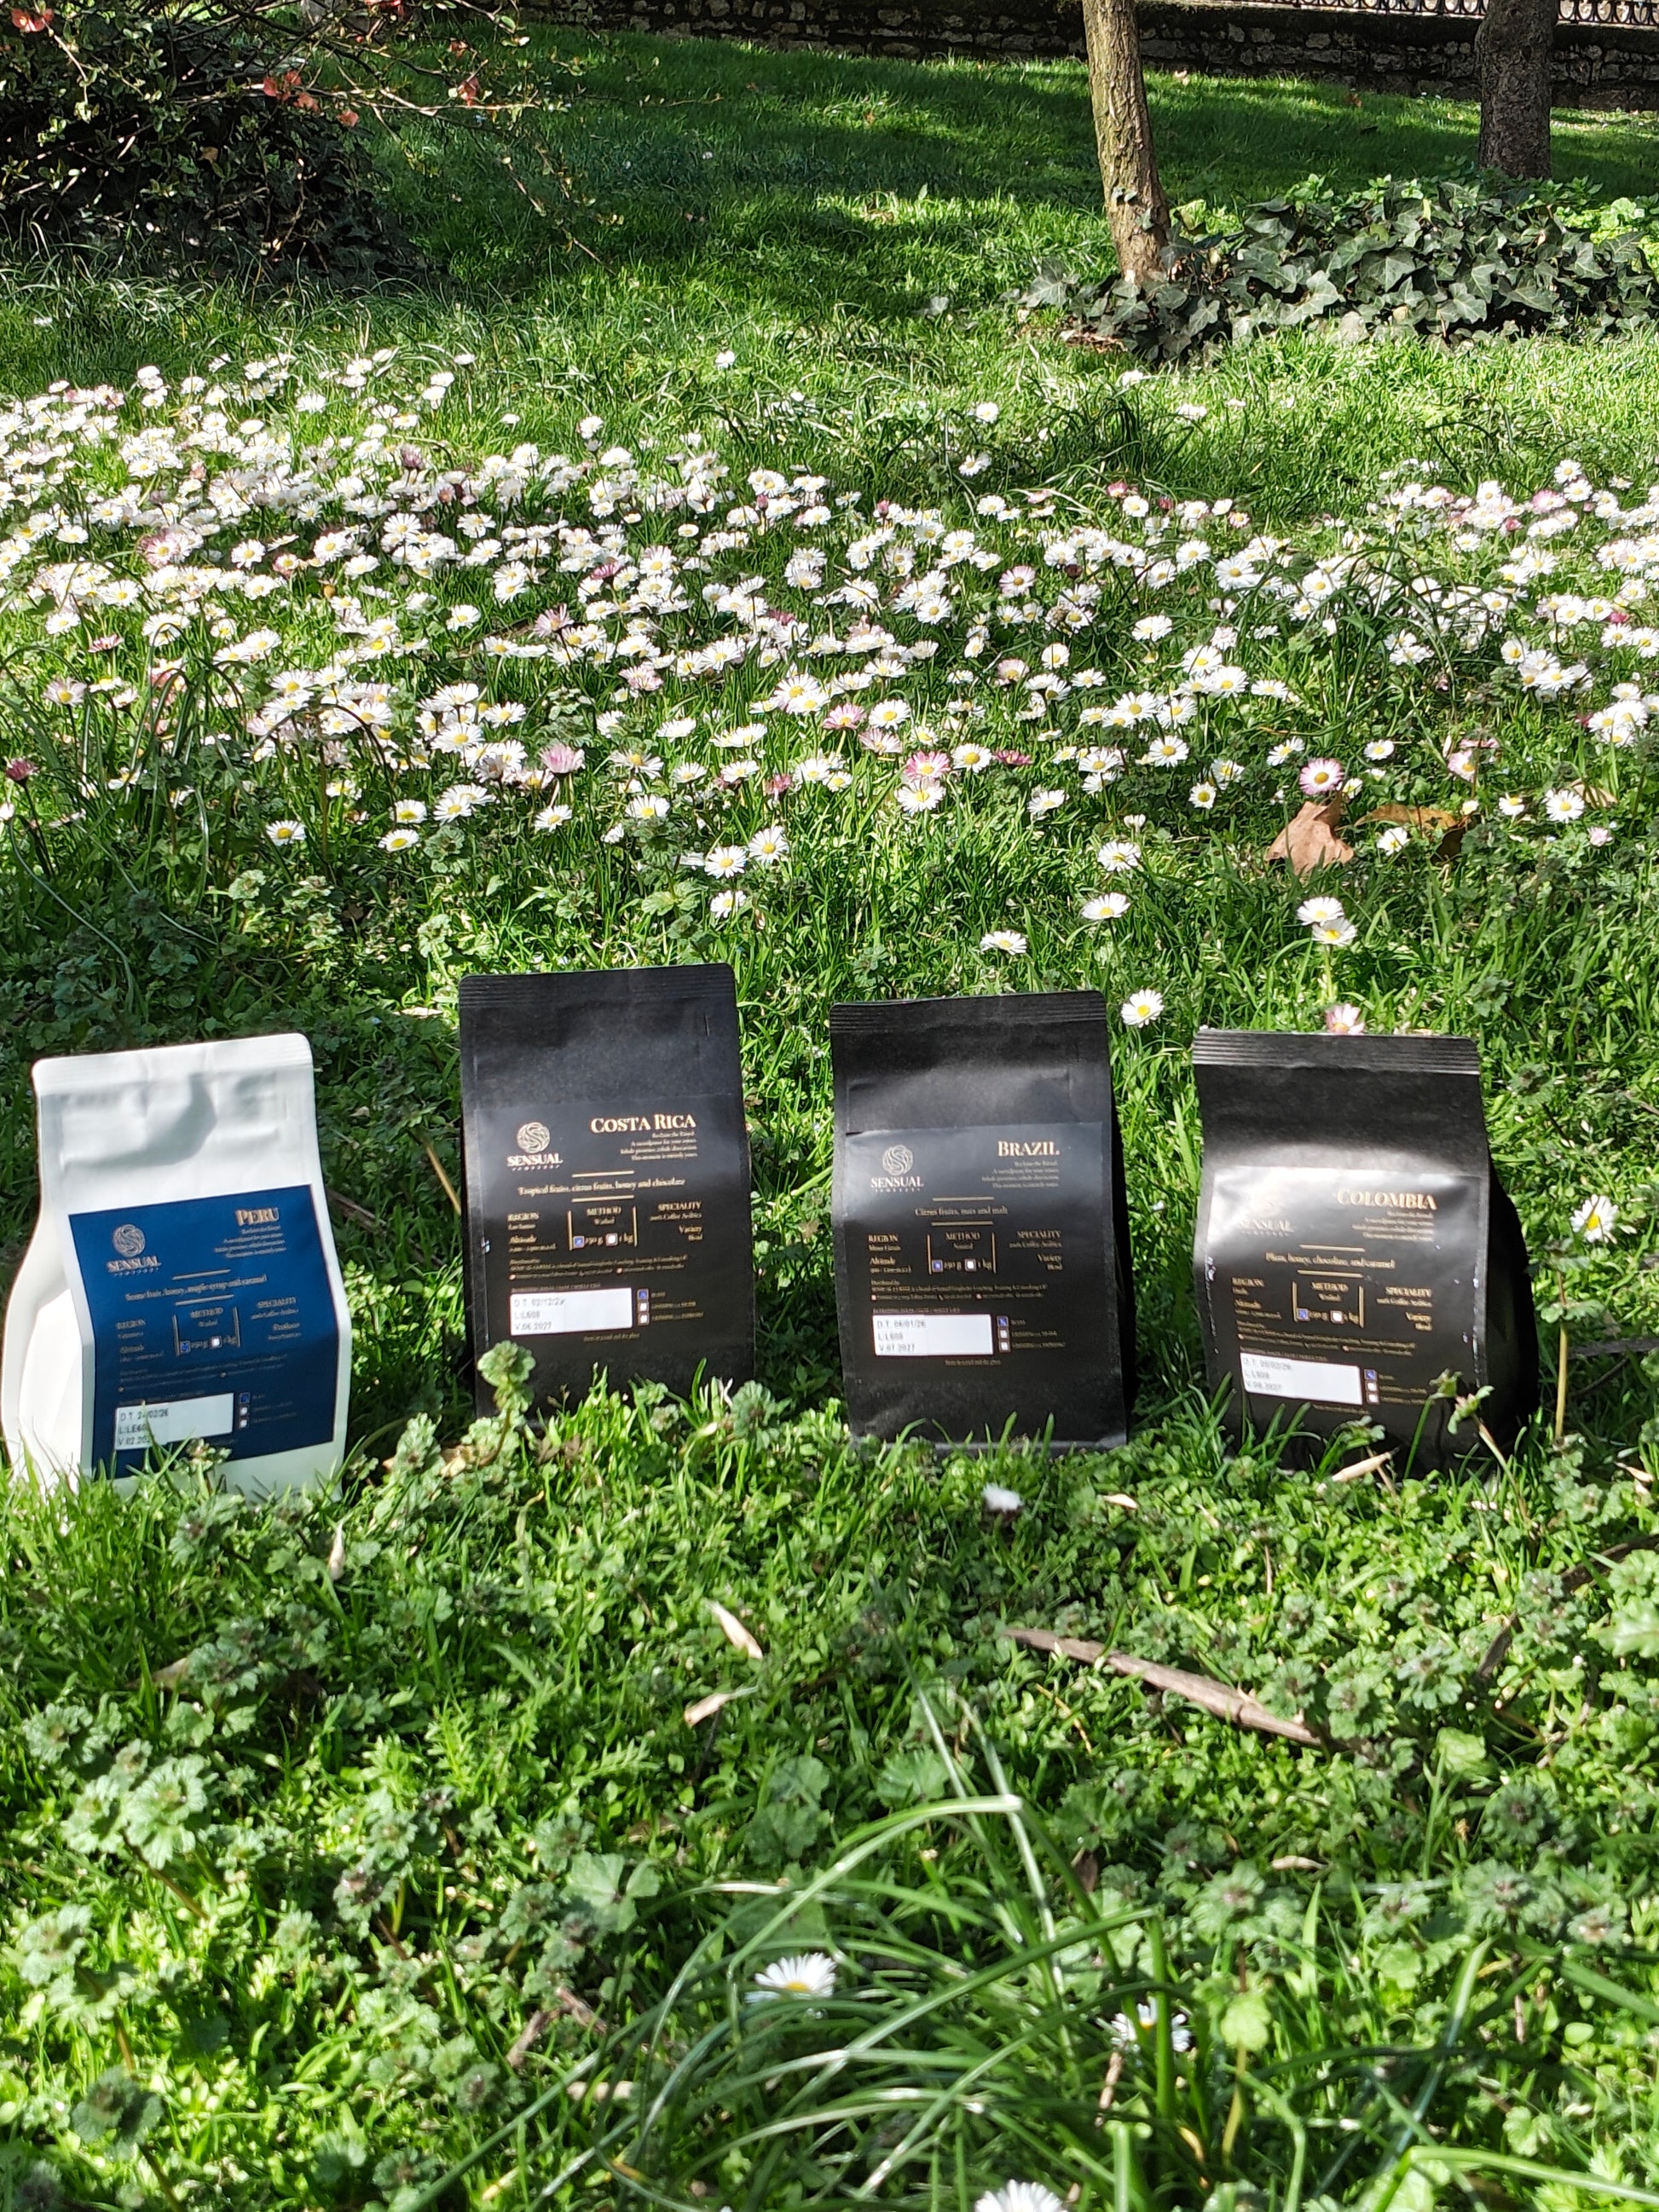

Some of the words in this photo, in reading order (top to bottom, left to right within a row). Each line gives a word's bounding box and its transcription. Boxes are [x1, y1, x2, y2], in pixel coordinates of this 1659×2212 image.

[591, 1118, 650, 1133] COSTA
[654, 1114, 697, 1130] RICA
[997, 1141, 1060, 1157] BRAZIL
[507, 1153, 564, 1166] SENSUAL
[870, 1176, 923, 1188] SENSUAL
[1337, 1188, 1437, 1210] COLOMBIA
[235, 1207, 280, 1226] PERU
[587, 1206, 621, 1216] METHOD
[107, 1256, 162, 1273] SENSUAL
